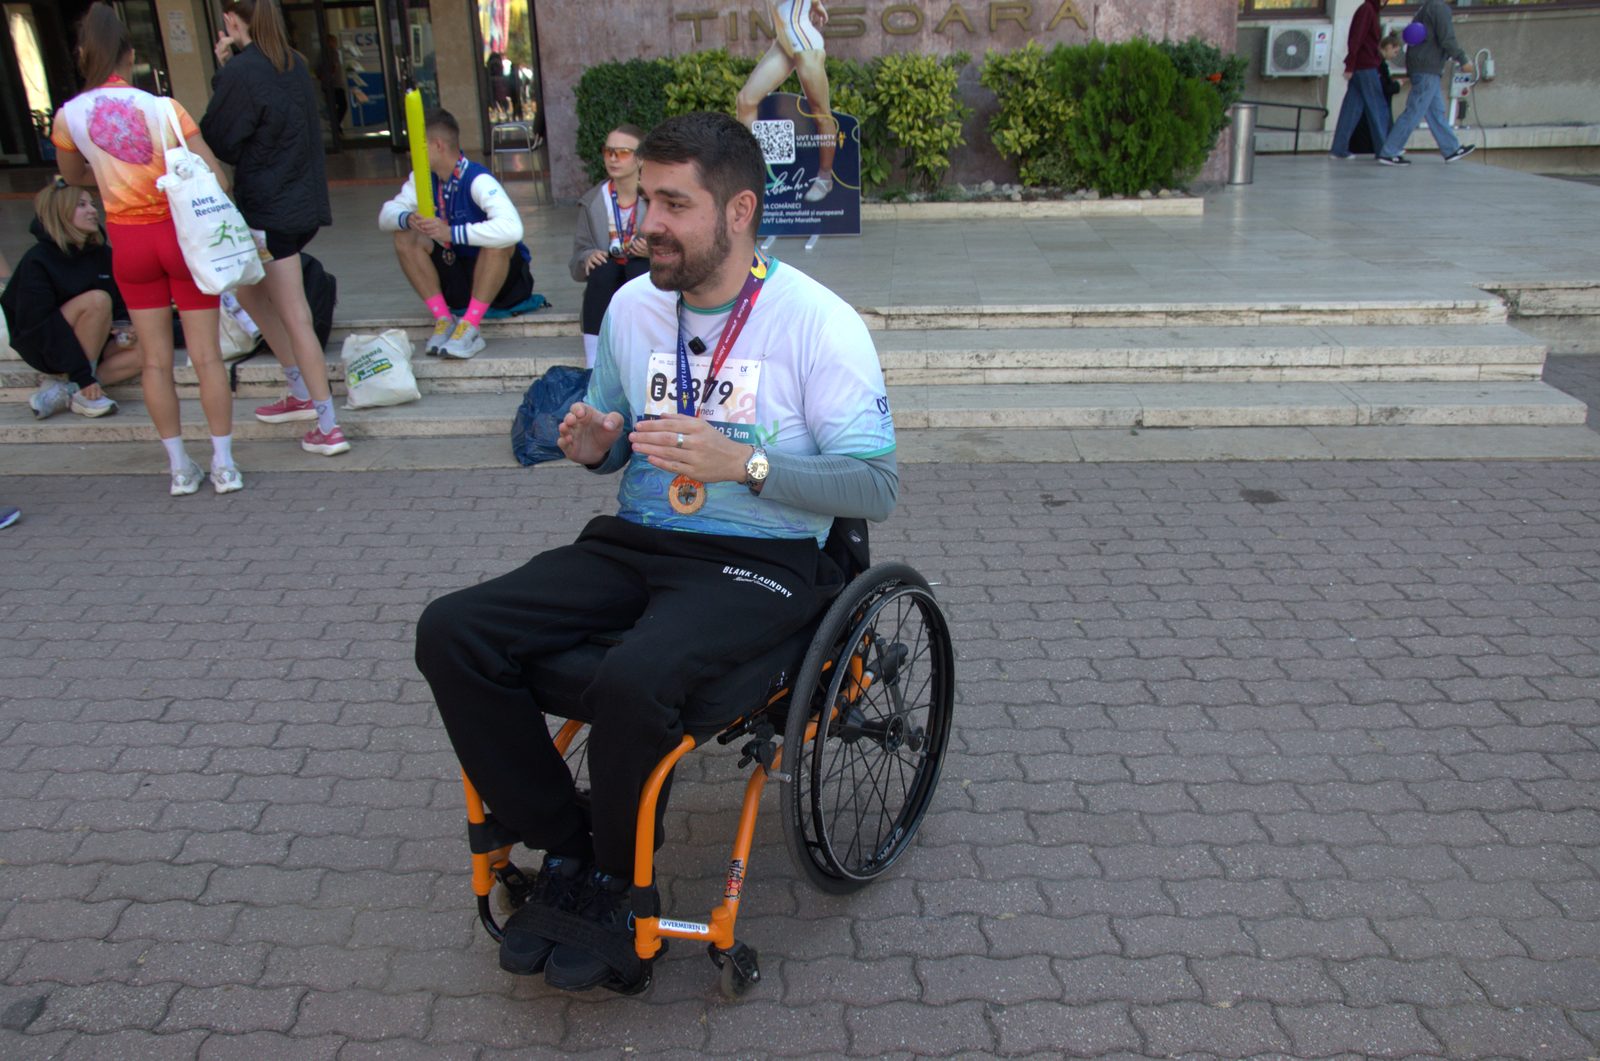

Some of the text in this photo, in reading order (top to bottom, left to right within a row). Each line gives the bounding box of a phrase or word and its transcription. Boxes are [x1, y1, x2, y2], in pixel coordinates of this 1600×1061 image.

[681, 374, 689, 389] UVT
[733, 428, 749, 439] km
[722, 565, 753, 577] BLANK
[753, 573, 792, 598] LAUNDRY
